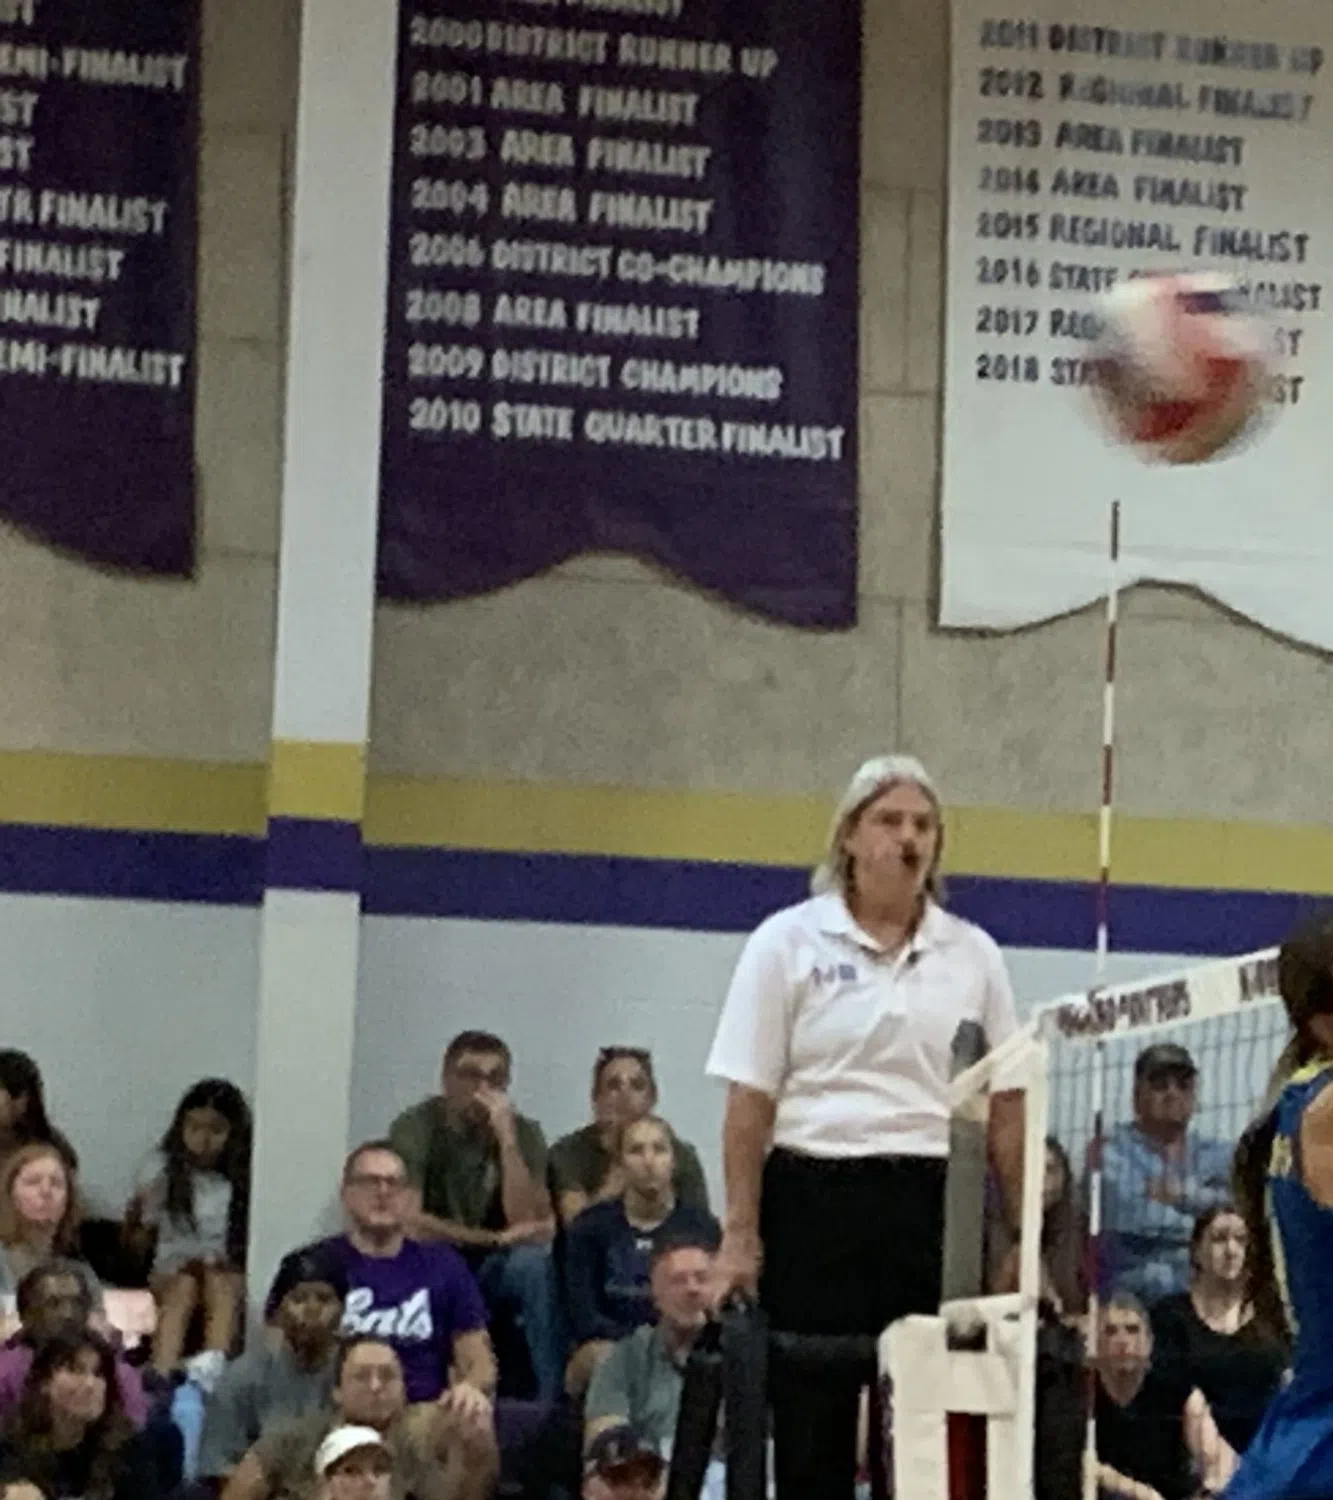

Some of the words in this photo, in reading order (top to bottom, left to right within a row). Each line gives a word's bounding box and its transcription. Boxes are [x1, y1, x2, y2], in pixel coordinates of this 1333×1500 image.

[739, 47, 779, 78] UP
[980, 66, 1043, 98] 2012
[411, 70, 482, 106] 2001
[490, 76, 565, 115] AREA
[578, 85, 699, 125] FINALIST
[501, 130, 575, 168] AREA
[587, 137, 712, 180] FINALIST
[976, 118, 1042, 148] 2013
[1055, 120, 1122, 155] AREA
[1131, 127, 1246, 167] FINALIST
[39, 189, 168, 234] FINALIST
[501, 182, 577, 223] AREA
[588, 191, 715, 236] FINALIST
[1051, 168, 1120, 199] AREA
[1133, 174, 1248, 212] FINALIST
[976, 211, 1041, 240] 2015
[1049, 213, 1182, 255] REGIONAL
[1193, 226, 1310, 263] FINALIST
[491, 239, 614, 278] DISTRICT
[617, 250, 827, 297] CO-CHAMPIONS
[976, 258, 1042, 288] 2016
[493, 294, 568, 330] AREA
[576, 303, 700, 339] FINALIST
[976, 306, 1038, 336] 2017
[408, 343, 484, 379] 2009
[492, 348, 611, 389] DISTRICT
[620, 358, 783, 401] CHAMPIONS
[976, 353, 1040, 383] 2018
[409, 396, 482, 434] 2010
[492, 402, 575, 441] STATE
[584, 409, 718, 451] QUARTER
[722, 420, 845, 461] FINALIST
